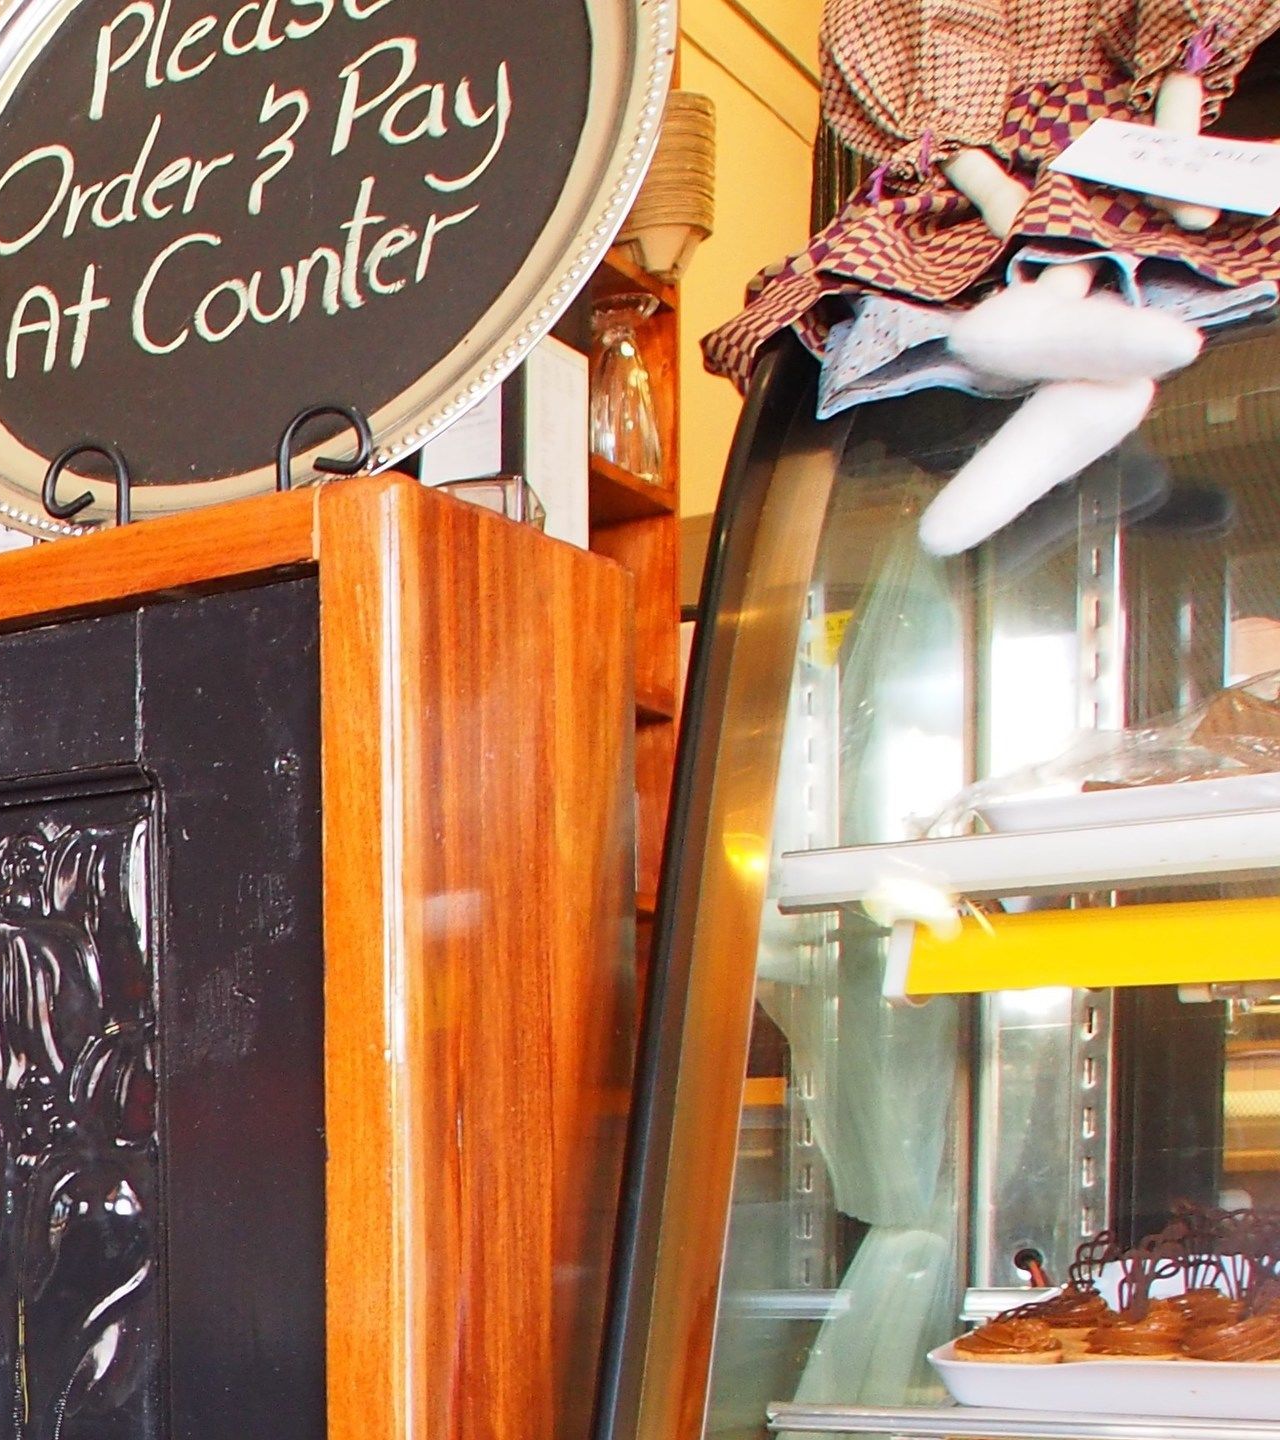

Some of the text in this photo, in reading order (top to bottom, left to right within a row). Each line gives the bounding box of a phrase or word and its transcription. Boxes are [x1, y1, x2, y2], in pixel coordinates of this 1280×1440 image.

[88, 0, 402, 121] Pleas
[330, 36, 512, 192] Pay
[4, 176, 479, 380] At Counter
